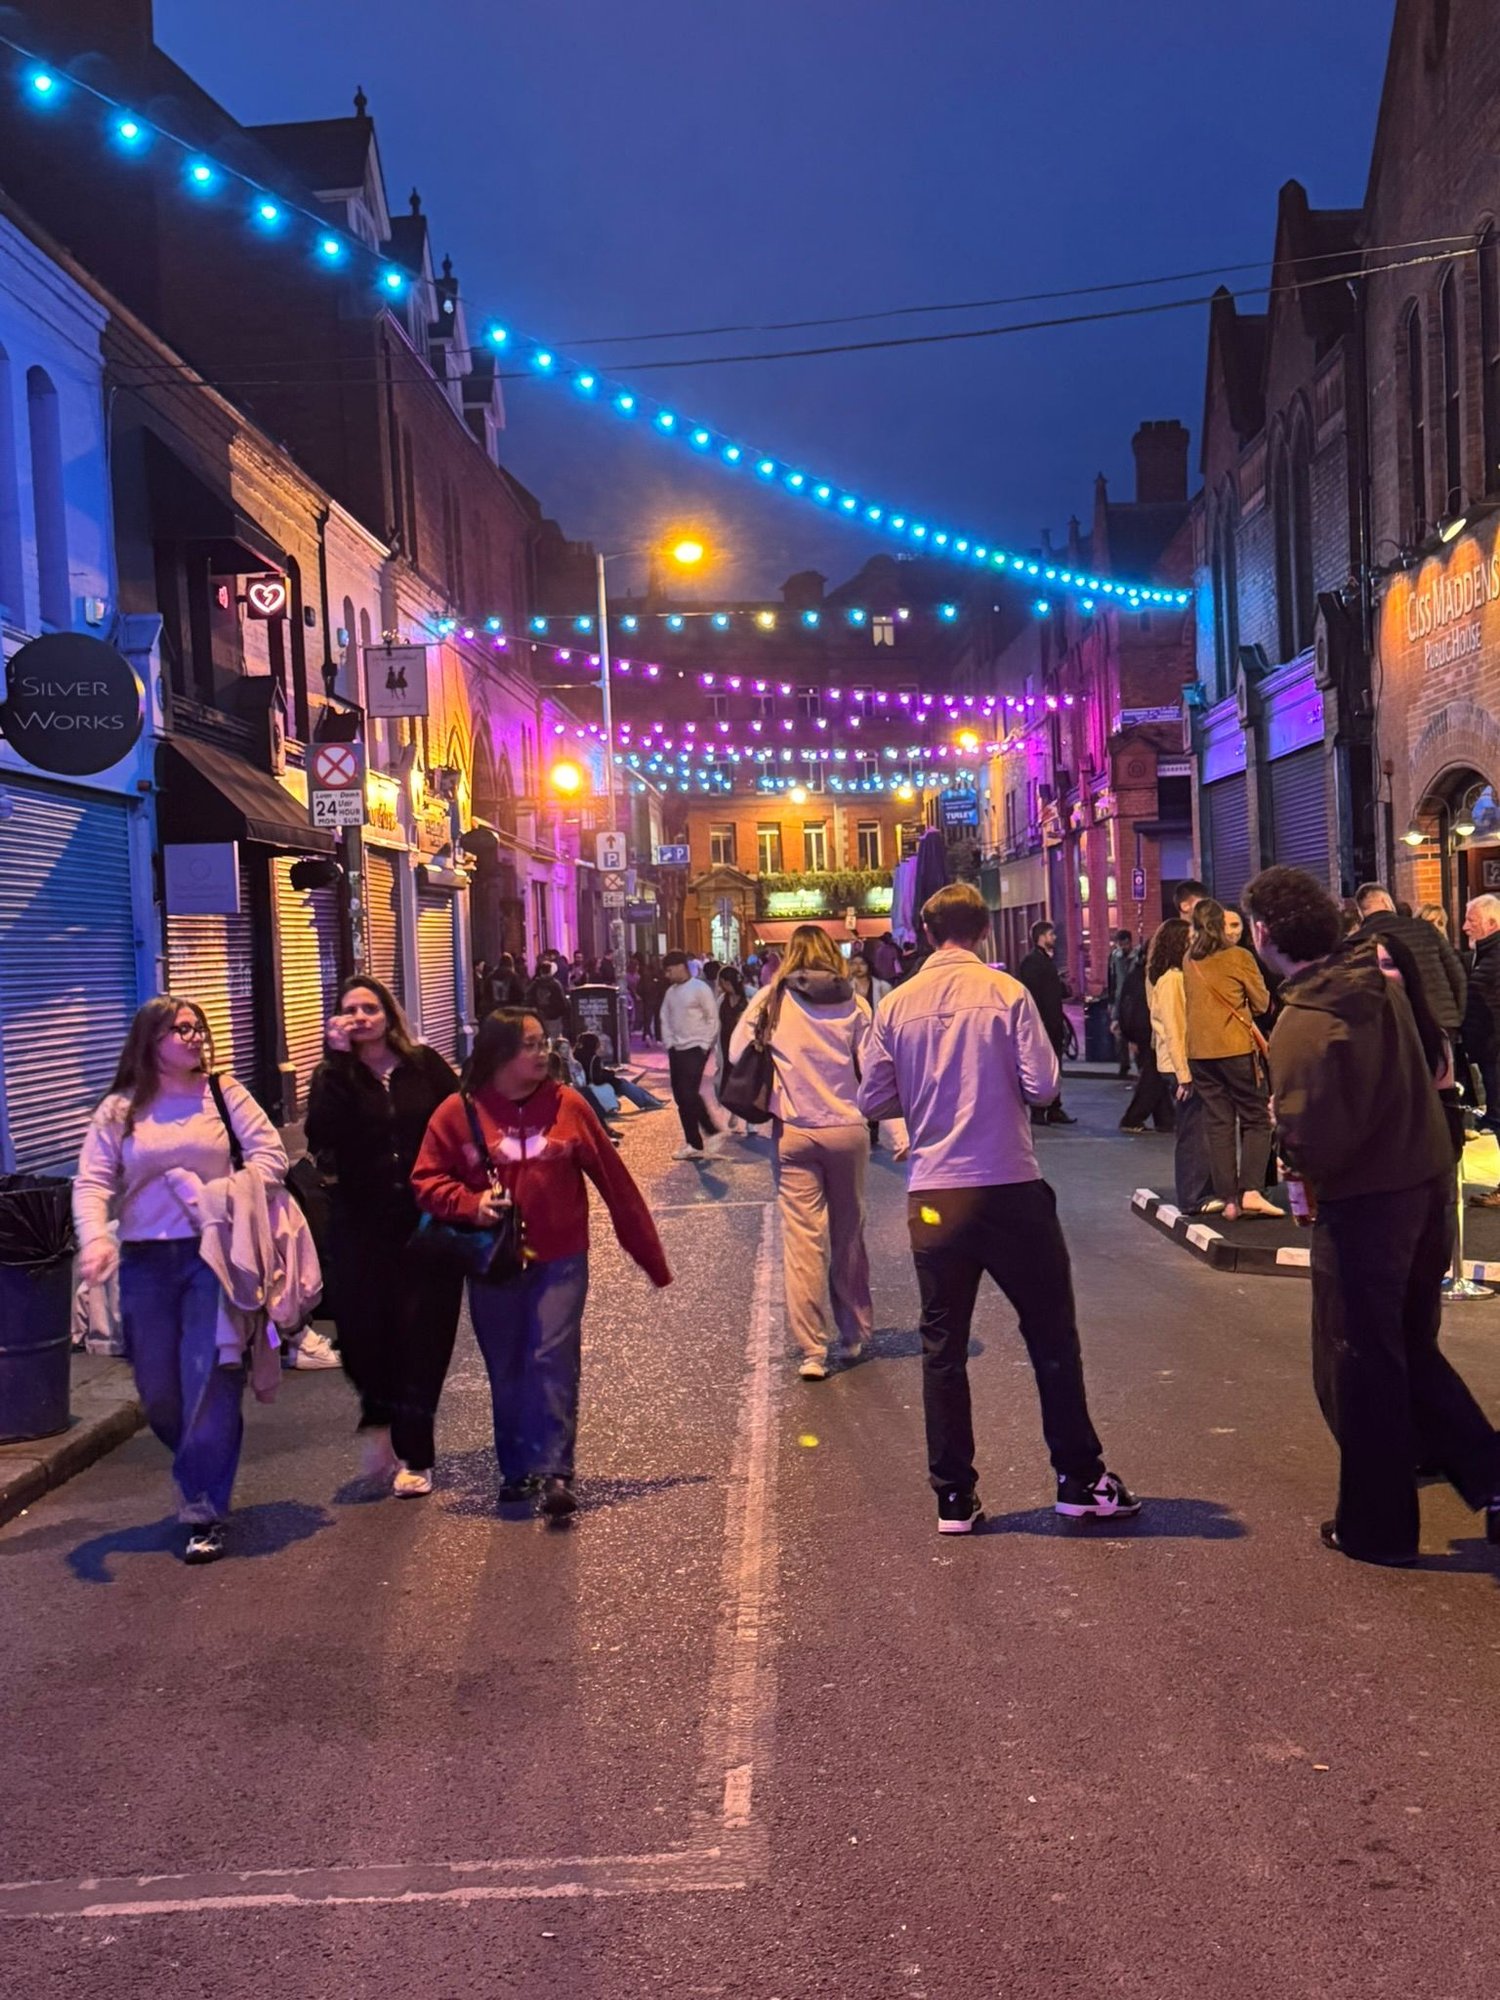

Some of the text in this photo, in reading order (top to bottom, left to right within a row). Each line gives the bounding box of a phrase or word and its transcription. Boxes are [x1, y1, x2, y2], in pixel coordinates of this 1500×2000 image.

[1407, 591, 1432, 643] CISS
[1425, 622, 1481, 672] PUBLIC HOUSE
[22, 677, 110, 697] SILVER
[13, 711, 124, 730] WORKS
[316, 800, 337, 816] 24
[339, 808, 361, 816] HOUR
[607, 853, 618, 866] P
